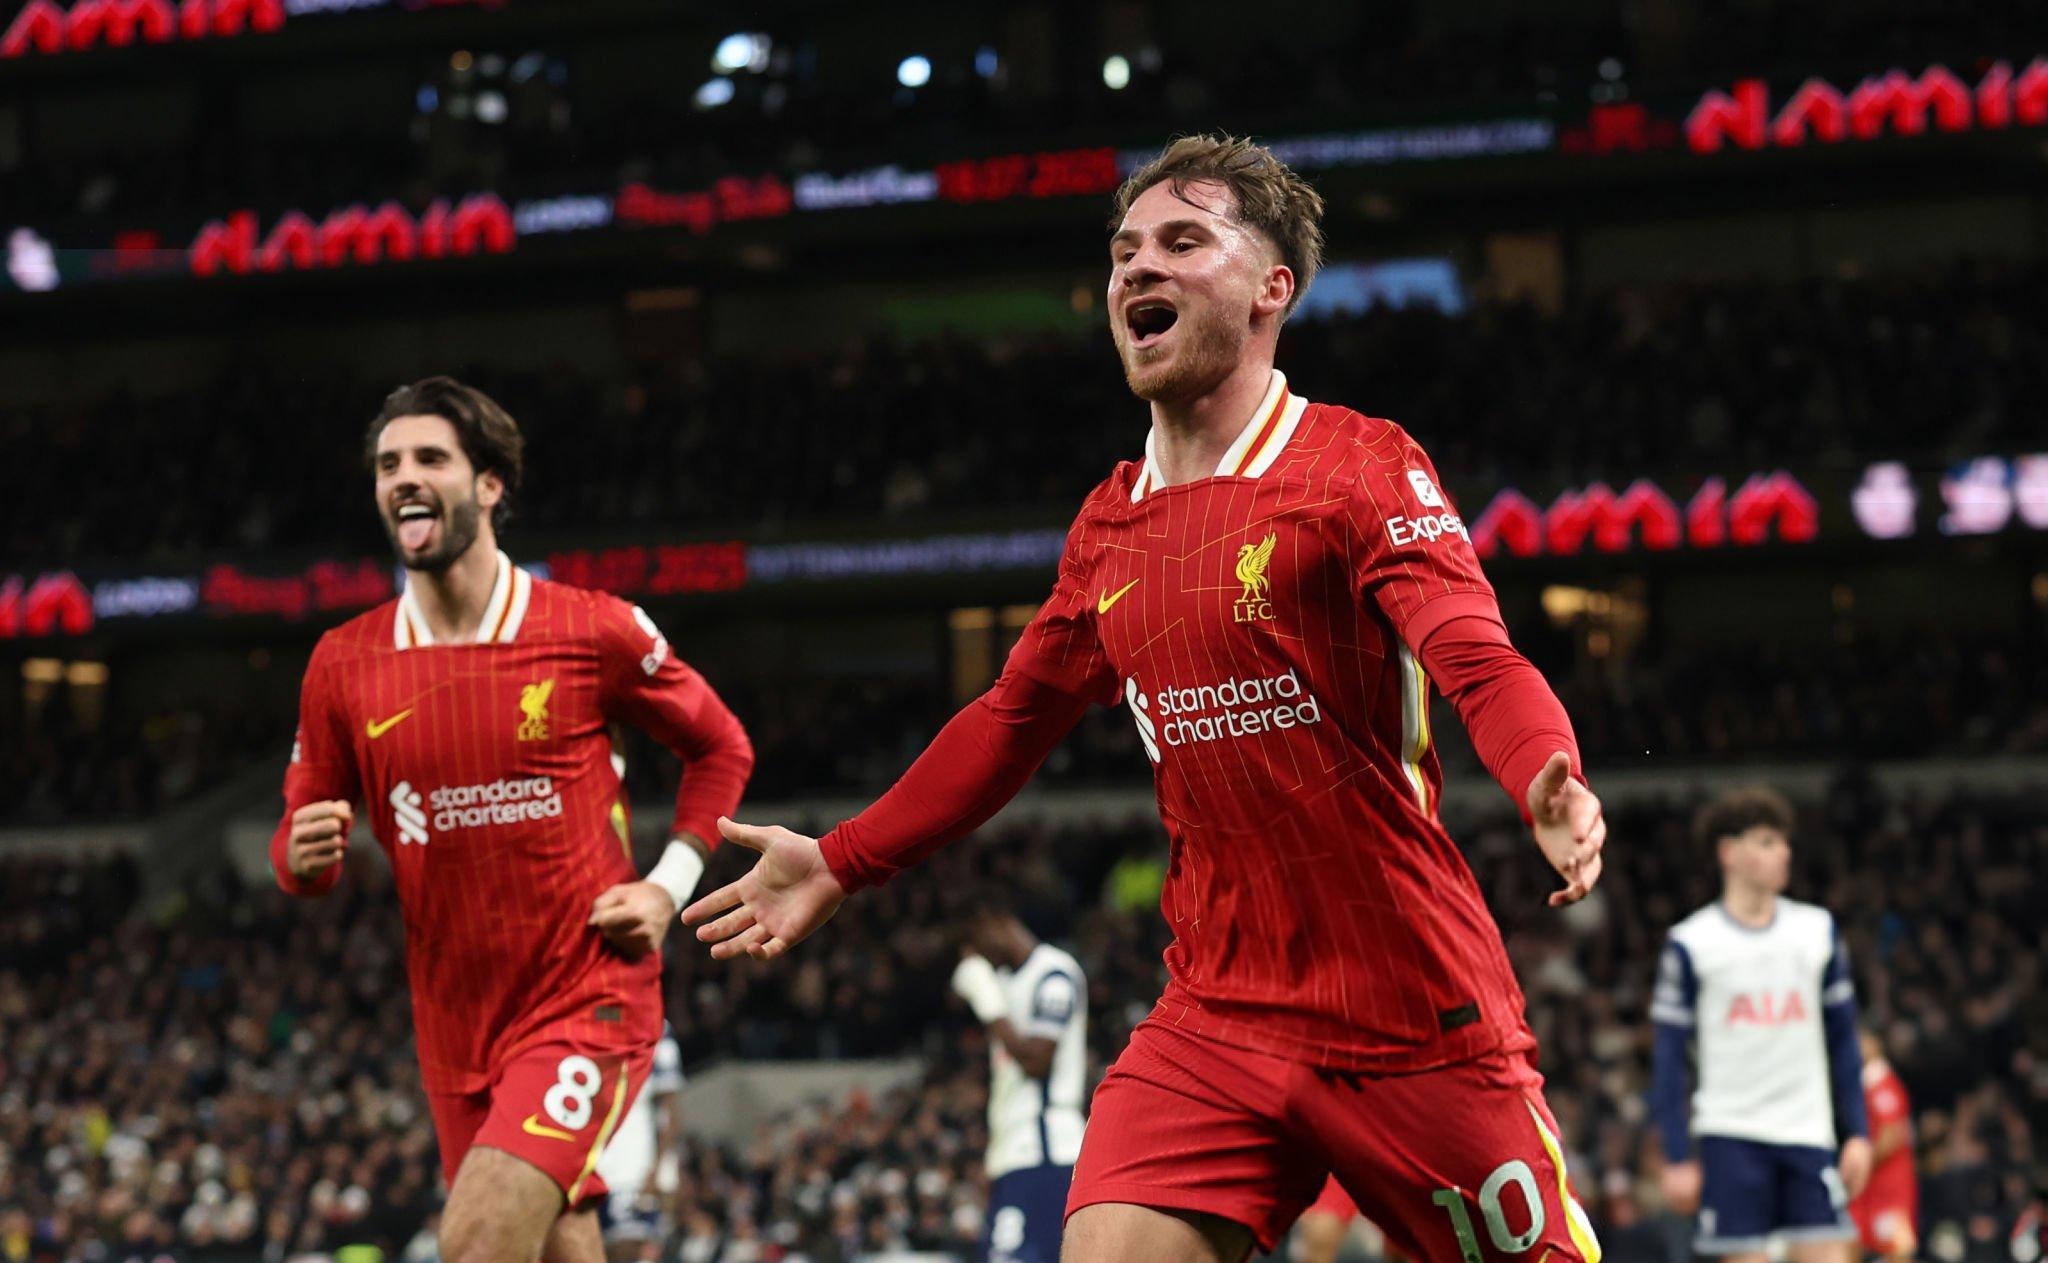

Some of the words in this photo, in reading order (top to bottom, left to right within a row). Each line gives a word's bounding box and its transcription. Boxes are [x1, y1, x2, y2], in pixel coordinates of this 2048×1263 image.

[1158, 667, 1301, 717] standard
[1163, 694, 1322, 747] chartered
[429, 776, 554, 810] standard
[434, 794, 563, 832] chartered
[1725, 989, 1808, 1026] AIA
[544, 1054, 602, 1131] 8
[1431, 1159, 1546, 1263] 10
